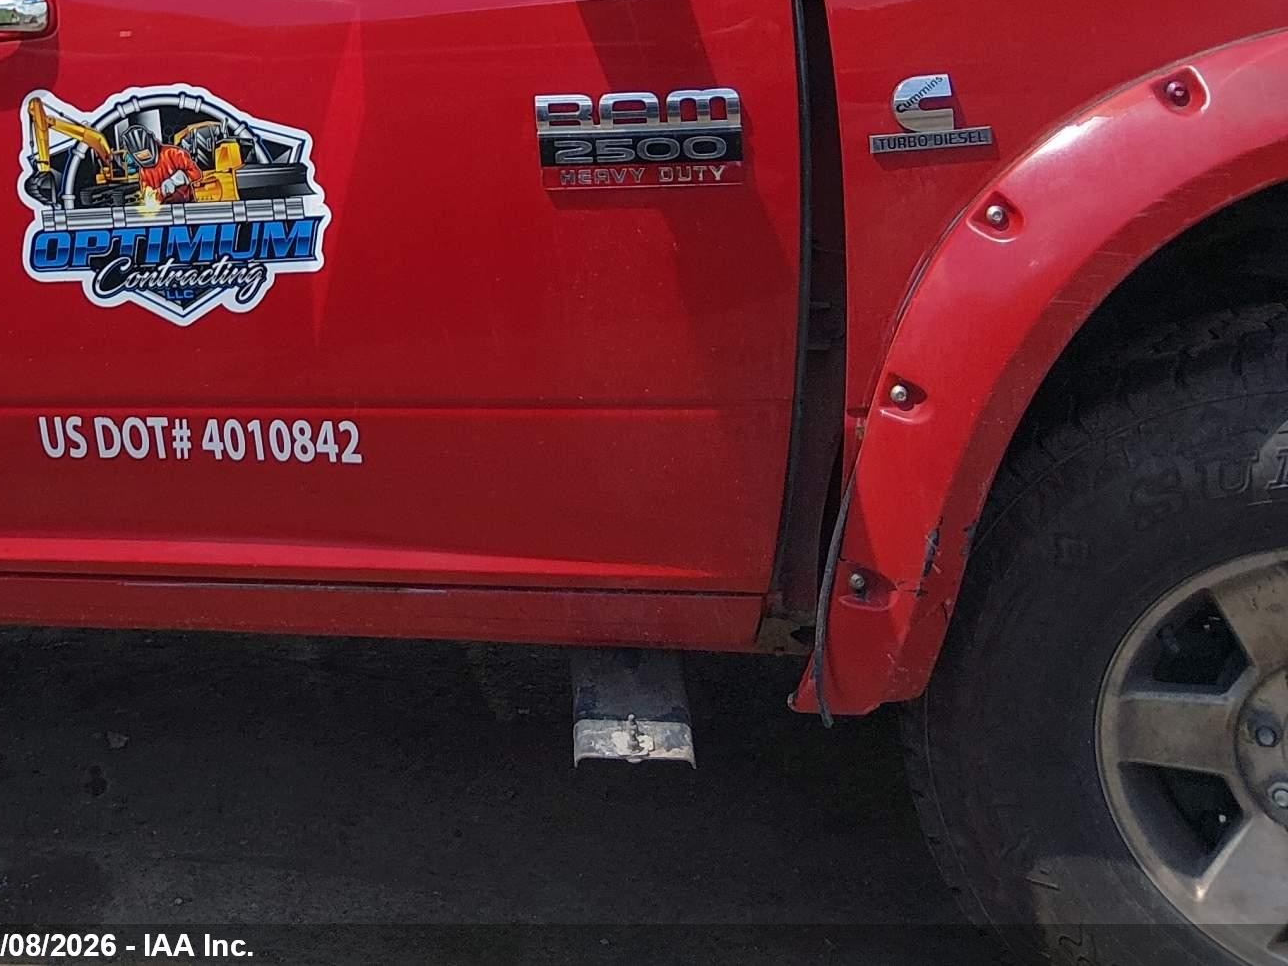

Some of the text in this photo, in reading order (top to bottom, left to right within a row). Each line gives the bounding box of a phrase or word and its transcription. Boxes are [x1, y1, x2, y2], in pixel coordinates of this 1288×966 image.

[534, 88, 742, 130] RAM
[554, 135, 727, 164] 2500
[879, 130, 984, 150] TURBO DIESEL
[560, 165, 726, 185] HEAVY DUTY
[33, 220, 315, 267] OPTIMUM
[95, 255, 264, 301] Contracting
[167, 290, 194, 299] LLC
[38, 416, 363, 463] US DOT# 4010842
